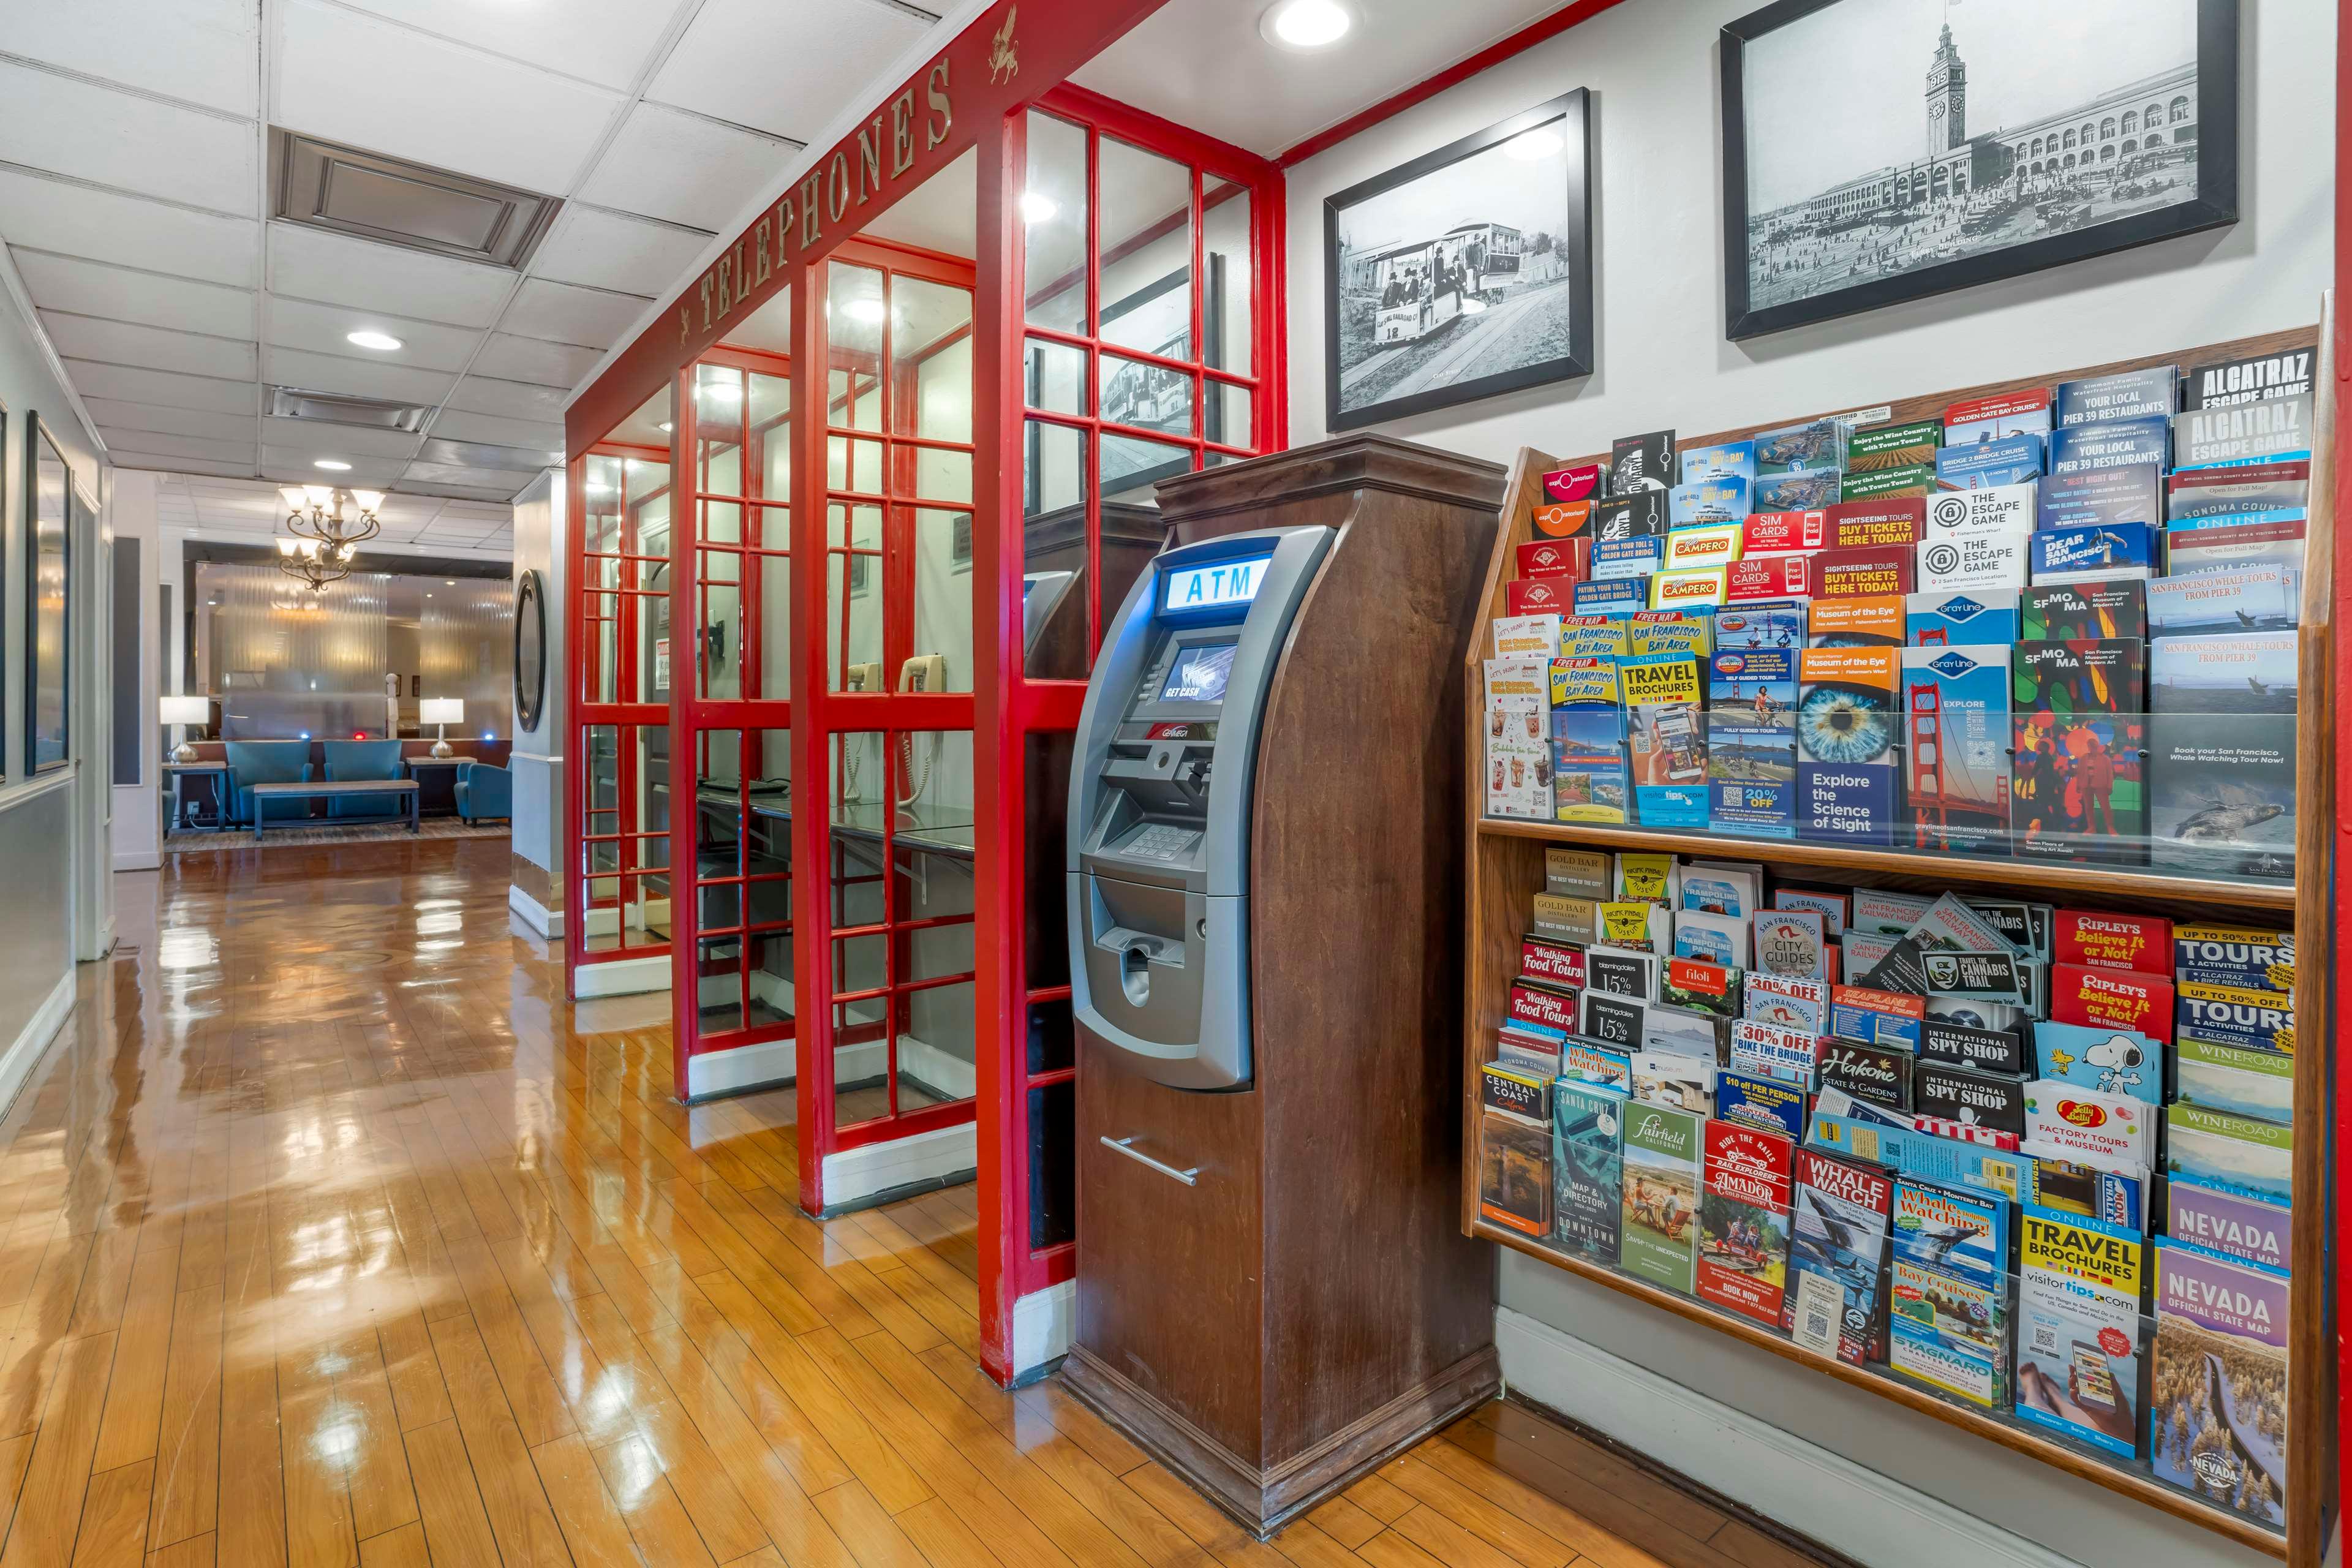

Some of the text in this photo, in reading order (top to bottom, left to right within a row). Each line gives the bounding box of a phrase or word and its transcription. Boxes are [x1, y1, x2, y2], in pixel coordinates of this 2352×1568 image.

[1928, 72, 1947, 89] 1915
[700, 58, 953, 333] TELEPHONES
[1387, 327, 1398, 339] 12
[2085, 391, 2141, 409] YOUR LOCAL
[1953, 414, 1980, 423] GOLDEN
[2064, 401, 2164, 424] PIER 39 RESTAURANTS
[2192, 401, 2299, 445] ALCATRAZ
[1900, 427, 1932, 437] Country
[1901, 436, 1922, 446] Tours!
[2192, 431, 2300, 461] ESCAPE GAME
[1760, 516, 1782, 526] SIM
[1839, 515, 1887, 524] SIGHTSEEING
[1839, 521, 1912, 534] BUY TICKETS
[1752, 525, 1788, 537] CARDS
[1839, 532, 1912, 546] HERE TODAY!
[1676, 541, 1727, 554] CAMPERO
[1964, 540, 1988, 550] THE
[2046, 534, 2084, 551] DEAR
[1964, 548, 2013, 561] ESCAPE
[2046, 548, 2069, 559] SAN
[2046, 542, 2112, 567] FRANCISCO
[1964, 561, 1999, 572] GAME
[1186, 566, 1250, 603] ATM
[1556, 658, 1592, 668] FREE MAP
[1637, 654, 1676, 664] ONLINE
[1869, 658, 1885, 666] Eye
[1553, 670, 1613, 686] SAN FRANCISCO
[1624, 665, 1694, 682] TRAVEL
[1166, 687, 1200, 697] GET CASH
[1565, 685, 1604, 697] BAY AREA
[1629, 682, 1694, 695] BROCHURES
[2198, 755, 2237, 763] Watching
[1812, 774, 1869, 788] Explore
[1745, 788, 1777, 801] 20%
[1812, 789, 1836, 801] the
[1751, 799, 1774, 808] OFF
[1813, 803, 1870, 817] Science
[1814, 816, 1871, 832] of Sight
[1915, 823, 2003, 835] graylineofsanfrancisco.com
[2078, 917, 2141, 934] RIPLEY'S
[1677, 935, 1732, 951] TRAMPOLINE
[2074, 931, 2145, 948] Believe It
[2222, 933, 2246, 942] 50%
[1692, 945, 1716, 956] PARK
[1775, 941, 1803, 952] CITY
[2084, 946, 2136, 960] or Not!
[2180, 940, 2295, 967] TOURS
[1765, 951, 1814, 965] GUIDES
[2100, 959, 2132, 970] FRANCISCO
[2197, 961, 2248, 970] ACTIVITIES
[1686, 968, 1709, 982] filoli
[1961, 965, 2008, 976] CANNABIS
[1962, 975, 1991, 987] TRAIL
[1525, 991, 1561, 1011] Walking
[1515, 1000, 1572, 1025] Food Tours
[1596, 1005, 1634, 1018] bloomingdales
[1599, 1017, 1627, 1039] 15%
[1744, 1026, 1811, 1052] 30% OFF
[1929, 1030, 2007, 1047] INTERNATIONAL
[1738, 1041, 1812, 1065] BIKE THE BRIDGE
[1929, 1038, 2008, 1061] SPY SHOP
[1822, 1049, 1896, 1083] Hakone
[1487, 1076, 1536, 1097] CENTRAL
[1726, 1077, 1800, 1104] $10 off PER PERSON
[1822, 1076, 1897, 1099] ESTATE GARDENS
[1493, 1087, 1529, 1103] COAST
[1561, 1091, 1608, 1114] SANTA CRUZ
[2073, 1102, 2094, 1115] Jelly
[2067, 1113, 2090, 1125] Belly
[1633, 1114, 1686, 1145] fairfield
[2039, 1125, 2128, 1148] FACTORY TOURS
[1645, 1137, 1682, 1152] CALIFORNIA
[1719, 1134, 1776, 1163] RIDE THE RAILS
[2065, 1137, 2113, 1155] MUSEUM
[1717, 1159, 1777, 1182] RAIL EXPLORERS
[1809, 1157, 1884, 1200] WHALE
[1572, 1182, 1589, 1194] MAP
[1714, 1172, 1777, 1210] AMADOR
[1812, 1174, 1877, 1210] WATCH
[1564, 1189, 1608, 1210] DIRECTORY
[1900, 1188, 1957, 1215] Whale
[1900, 1200, 1990, 1238] Watching!
[1559, 1216, 1614, 1244] DOWNTOWN
[2027, 1219, 2136, 1267] TRAVEL
[1656, 1245, 1688, 1262] UNEXPECTED
[2029, 1242, 2132, 1280] BROCHURES
[1723, 1283, 1759, 1302] BOOK NOW
[1899, 1266, 1985, 1304] Bay Cruises!
[2056, 1296, 2071, 1305] Things
[2169, 1273, 2271, 1323] NEVADA
[2168, 1298, 2271, 1336] OFFICIAL STATE MAP
[1894, 1335, 1989, 1376] STAGNARO
